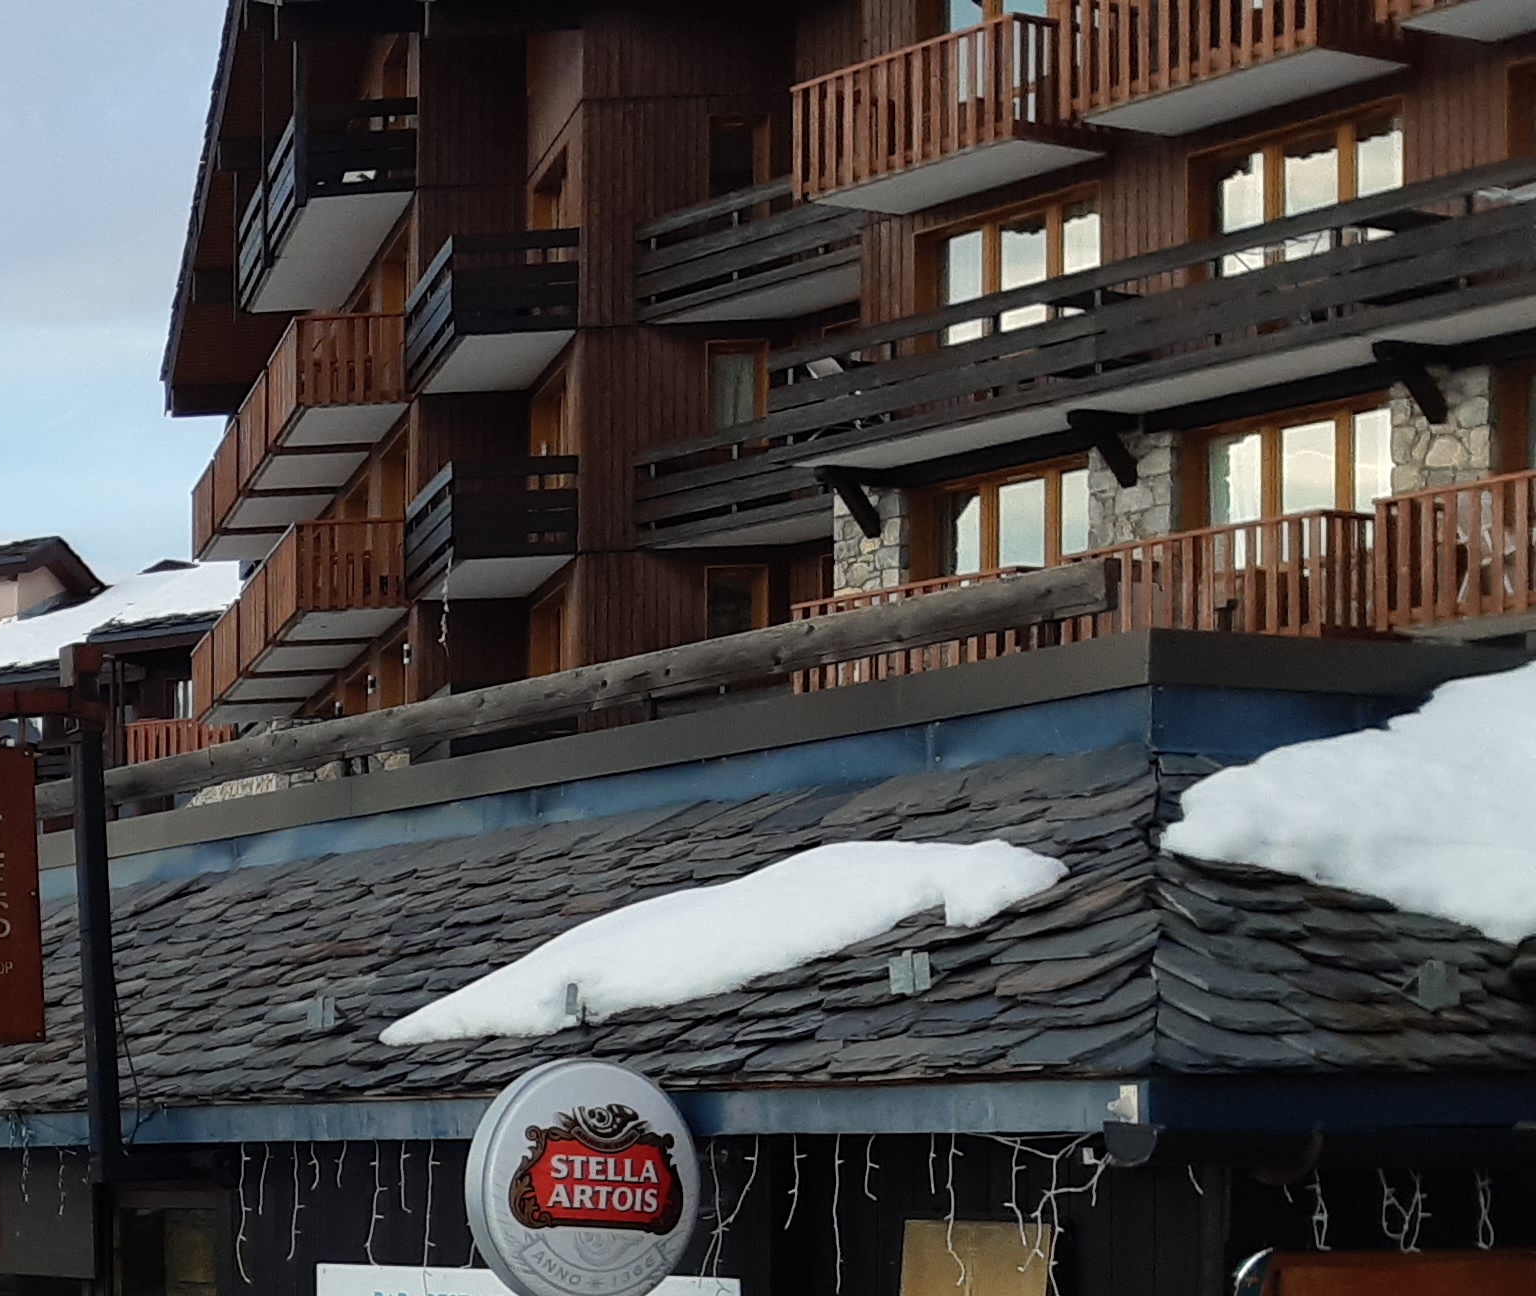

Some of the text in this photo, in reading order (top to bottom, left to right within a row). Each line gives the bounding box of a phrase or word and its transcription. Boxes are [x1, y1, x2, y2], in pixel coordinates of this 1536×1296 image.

[550, 1154, 659, 1184] STELLA
[547, 1184, 658, 1213] ARTOIS
[531, 1251, 582, 1286] ANNO
